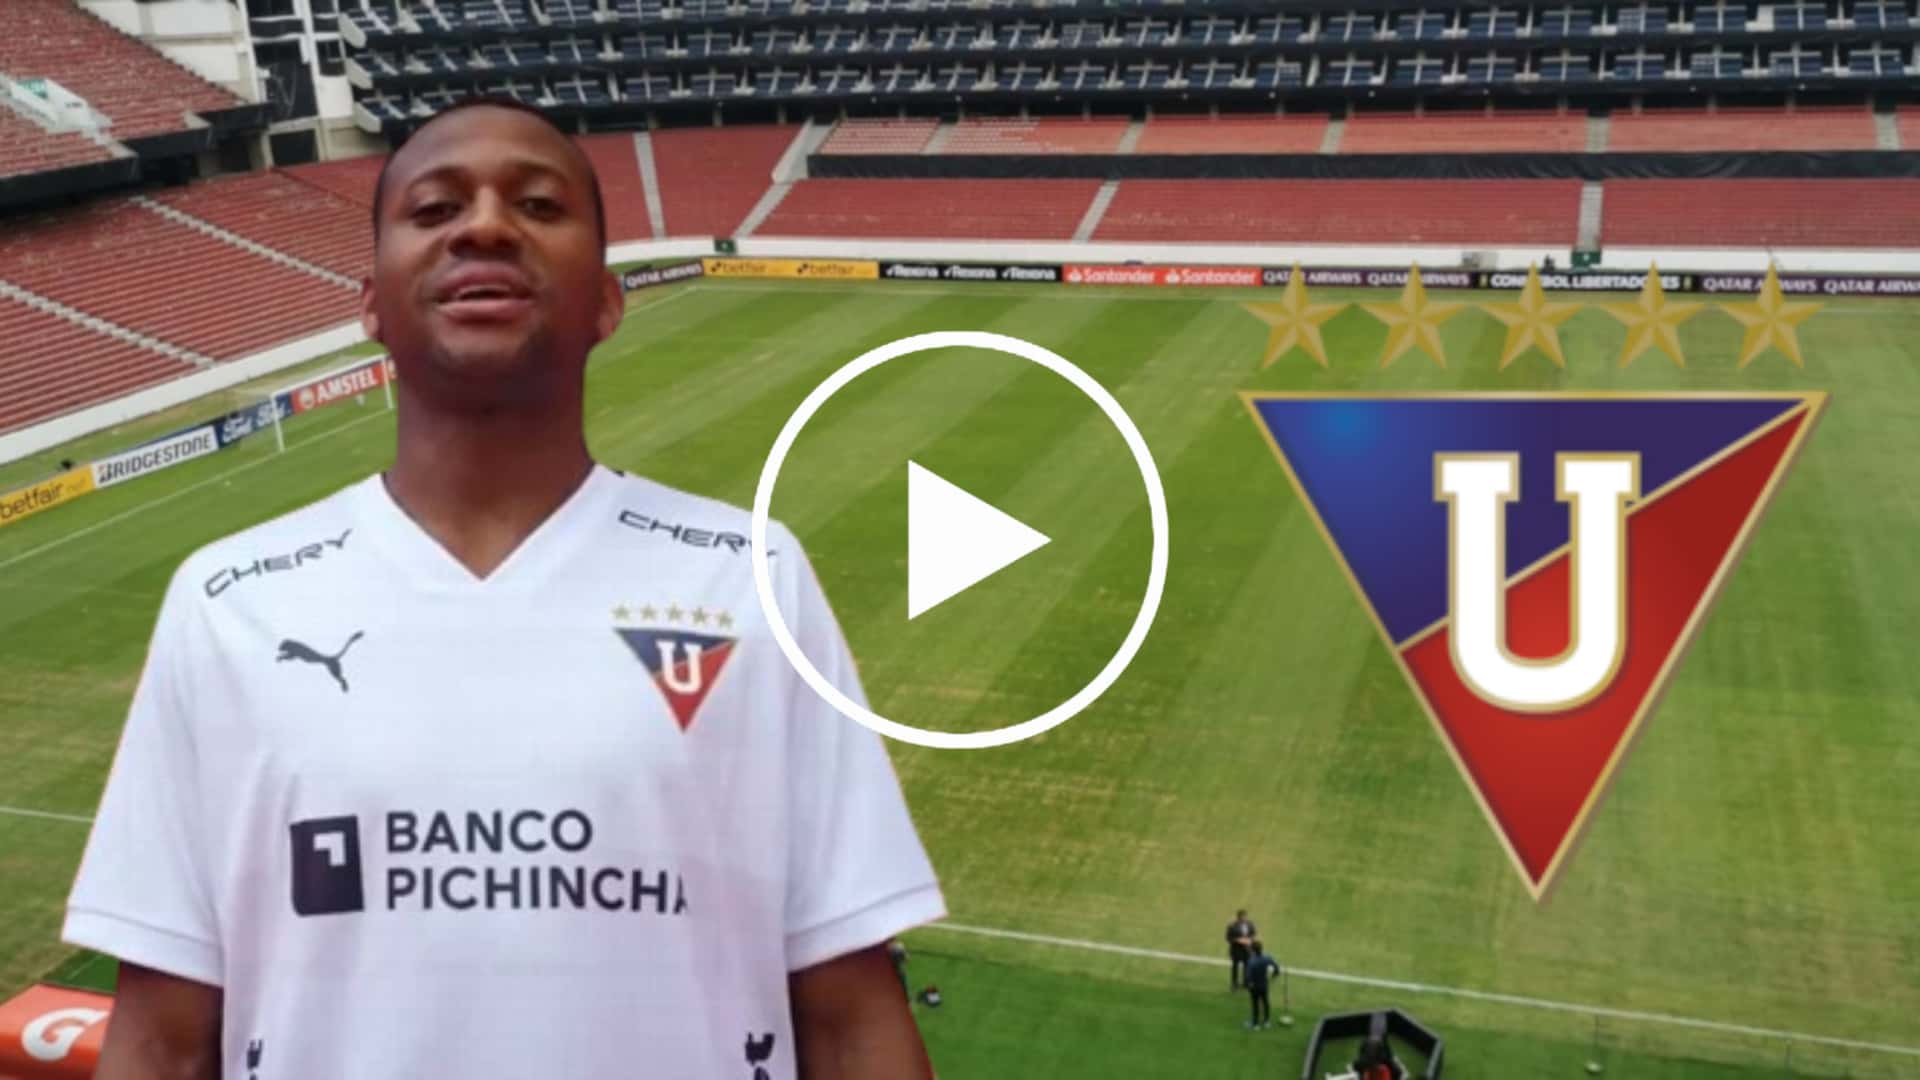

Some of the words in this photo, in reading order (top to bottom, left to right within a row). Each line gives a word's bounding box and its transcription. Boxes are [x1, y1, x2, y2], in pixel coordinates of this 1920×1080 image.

[1084, 267, 1155, 283] Santander
[1182, 269, 1256, 284] Santander
[1703, 277, 1752, 292] QATAR
[1824, 279, 1875, 295] QATAR
[316, 369, 377, 402] AMSTEL
[99, 433, 211, 483] BRIDGESTONE
[618, 510, 777, 557] CHER
[205, 528, 353, 598] CHERY
[656, 640, 702, 695] U
[386, 809, 593, 854] BANCO
